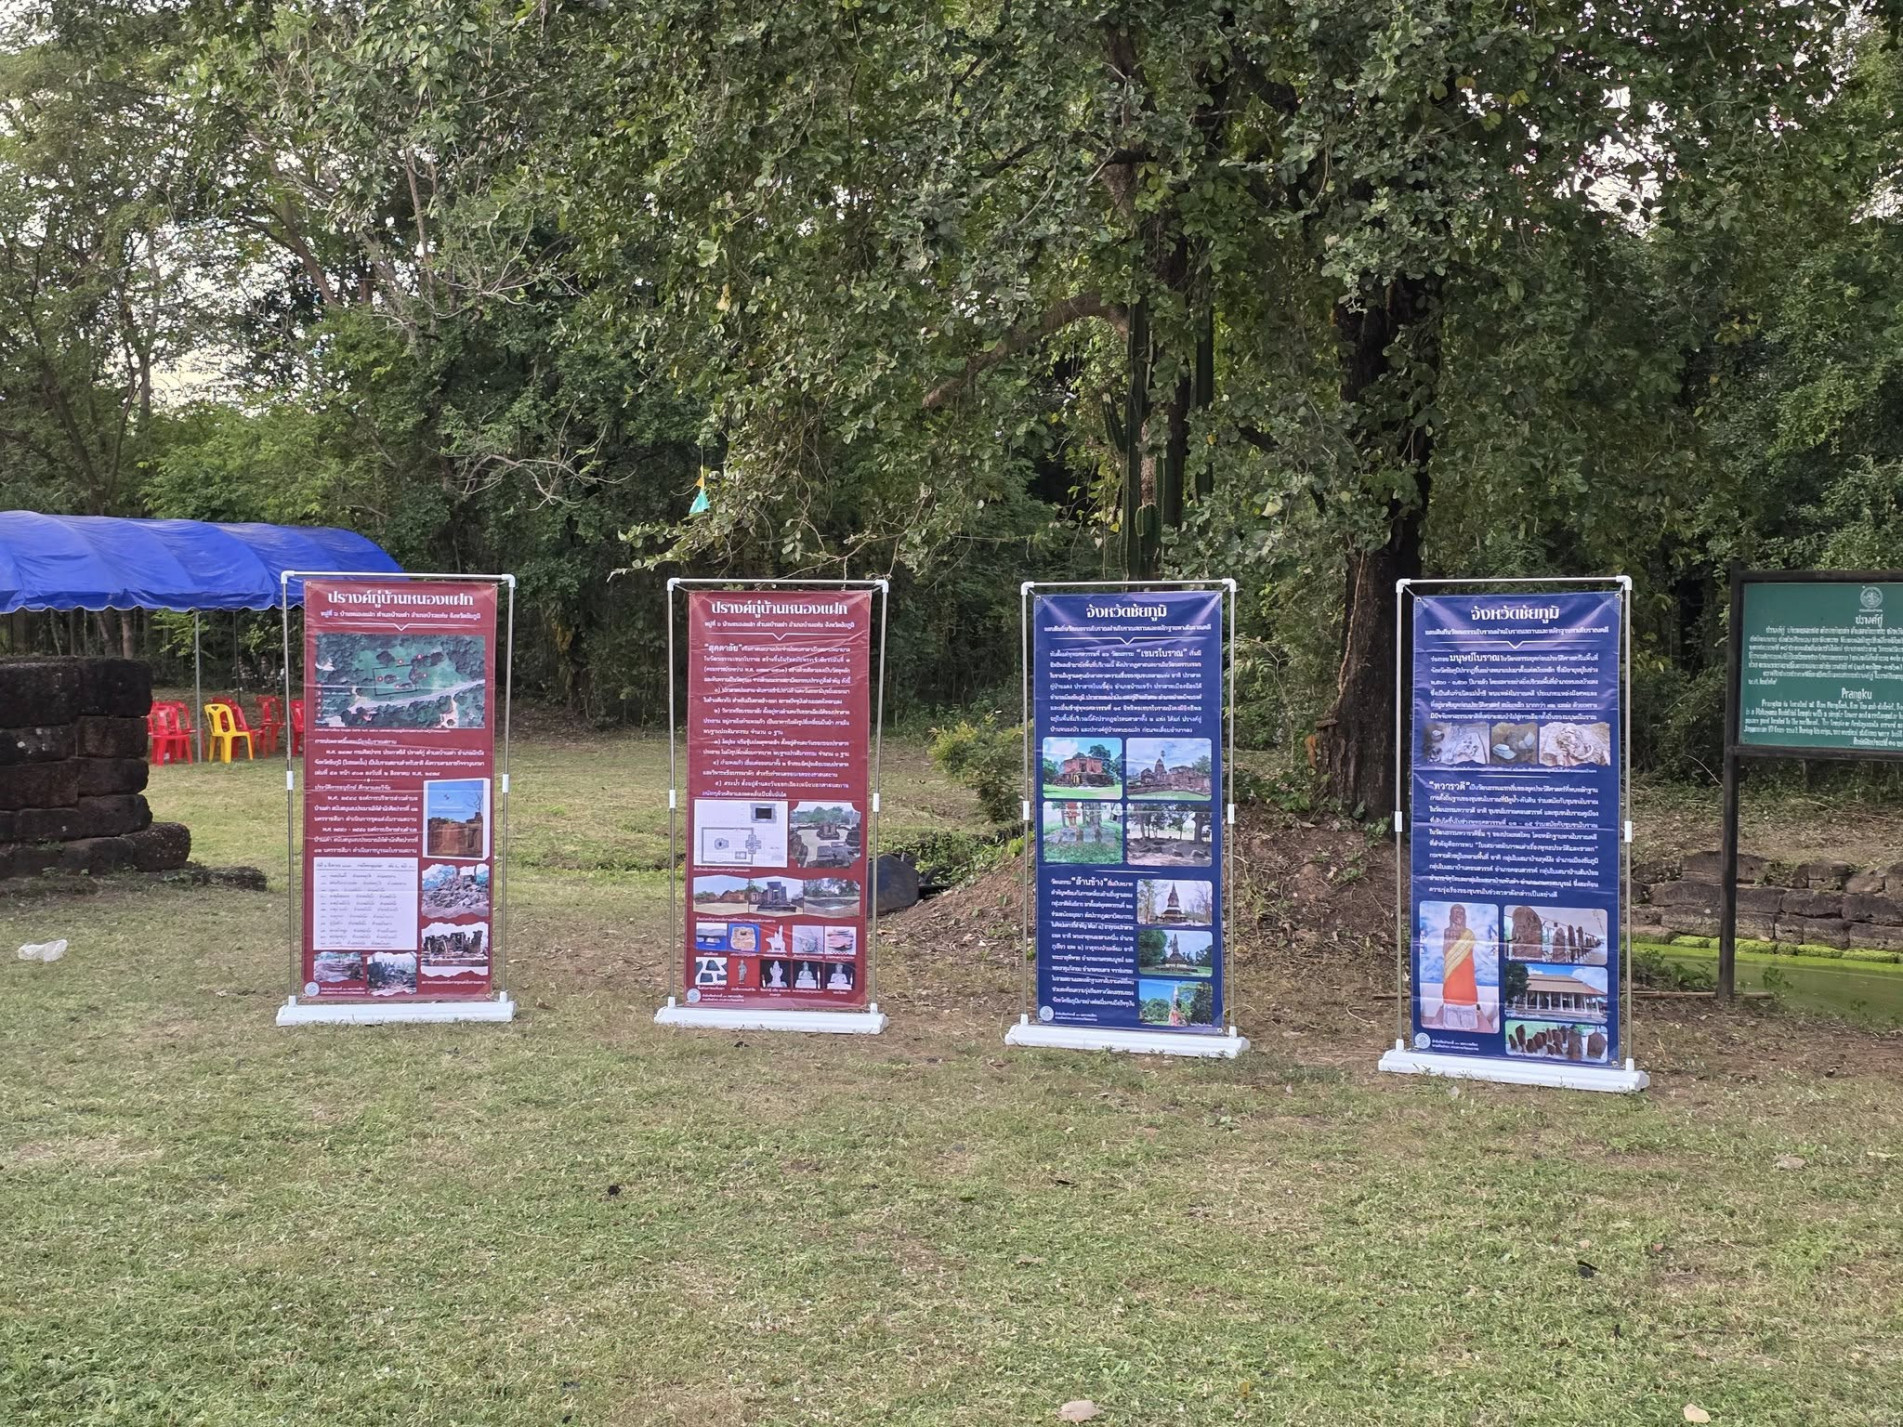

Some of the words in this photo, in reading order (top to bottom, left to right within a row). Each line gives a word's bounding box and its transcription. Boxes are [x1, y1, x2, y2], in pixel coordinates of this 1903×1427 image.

[328, 590, 473, 608] ปรางค์กู่บ้านหนองแฝก
[712, 600, 847, 618] ปรางค์กู่บ้านหนองแฝก
[1086, 604, 1167, 621] จังหวัดชัยภูมิ
[1471, 605, 1559, 623] จังหวัดชัยภูมิ
[1855, 614, 1883, 629] ปรางค์กู่
[1136, 648, 1187, 658] "เขมรโบราณ"
[1449, 652, 1500, 664] มนุษย์โบราณ
[1841, 687, 1873, 701] Prangku
[1429, 780, 1470, 791] "ทวารวดี"
[1071, 876, 1108, 887] "ล้านช้าง"
